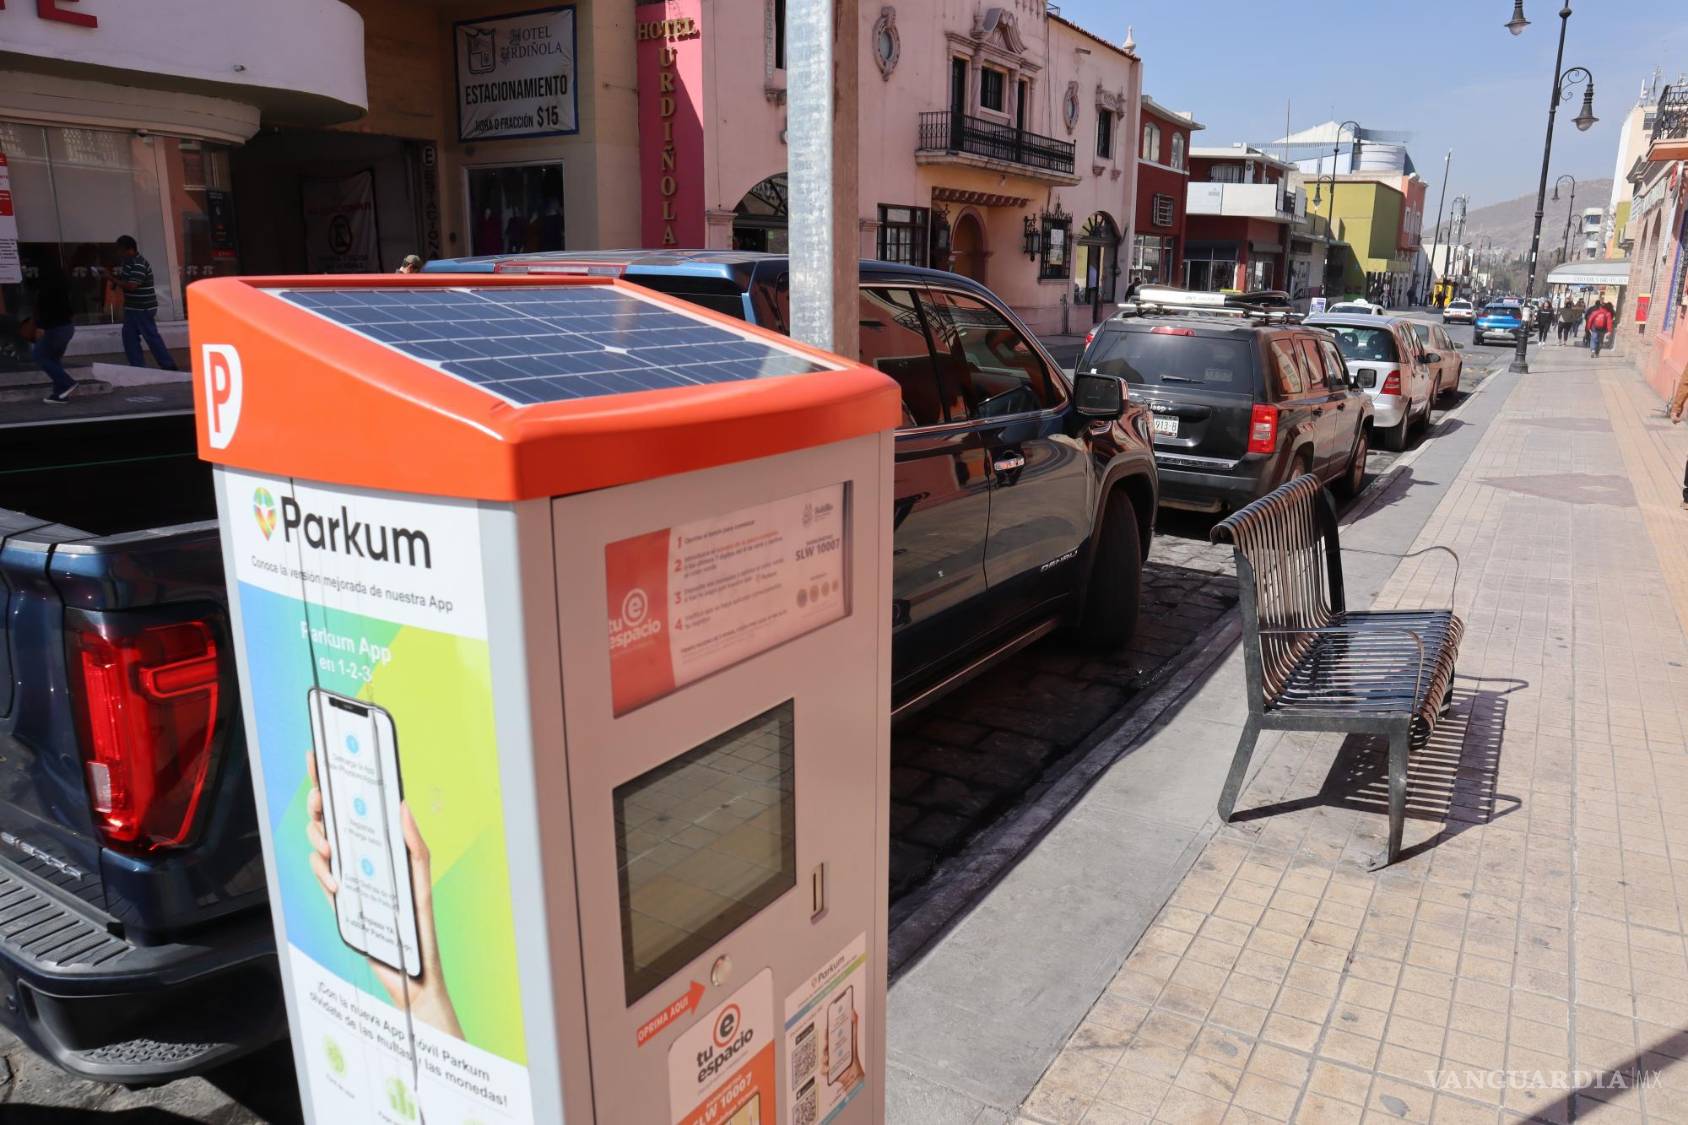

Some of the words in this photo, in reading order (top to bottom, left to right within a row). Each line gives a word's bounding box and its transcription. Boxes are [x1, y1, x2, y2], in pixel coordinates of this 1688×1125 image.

[637, 18, 697, 40] HOTEL
[465, 75, 568, 105] ESTACIONAMIENTO
[658, 47, 677, 245] URDIÑOLA
[281, 496, 431, 569] Parkum
[677, 536, 682, 549] 1
[795, 546, 814, 561] SLW
[816, 537, 841, 554] 10007
[674, 559, 682, 573] 2
[323, 574, 367, 594] mejorada
[369, 585, 382, 598] de
[385, 589, 426, 607] nuestra
[429, 595, 453, 613] App
[674, 591, 682, 605] 3
[674, 618, 683, 631] 4
[301, 621, 356, 655] Parkum
[359, 636, 392, 667] App
[319, 656, 335, 673] en
[338, 658, 372, 683] 1-2-3
[818, 956, 845, 982] Parkum
[318, 980, 338, 1001] Con
[350, 1003, 381, 1027] nueva
[383, 1020, 405, 1041] App
[442, 1049, 491, 1082] Parkum
[638, 1012, 669, 1042] OPRIMA
[359, 1021, 374, 1041] las
[377, 1034, 412, 1062] multas
[424, 1057, 443, 1078] las
[444, 1068, 509, 1109] monedas!
[696, 1045, 714, 1068] tu
[697, 1028, 753, 1084] espacio
[720, 1071, 753, 1109] 10007
